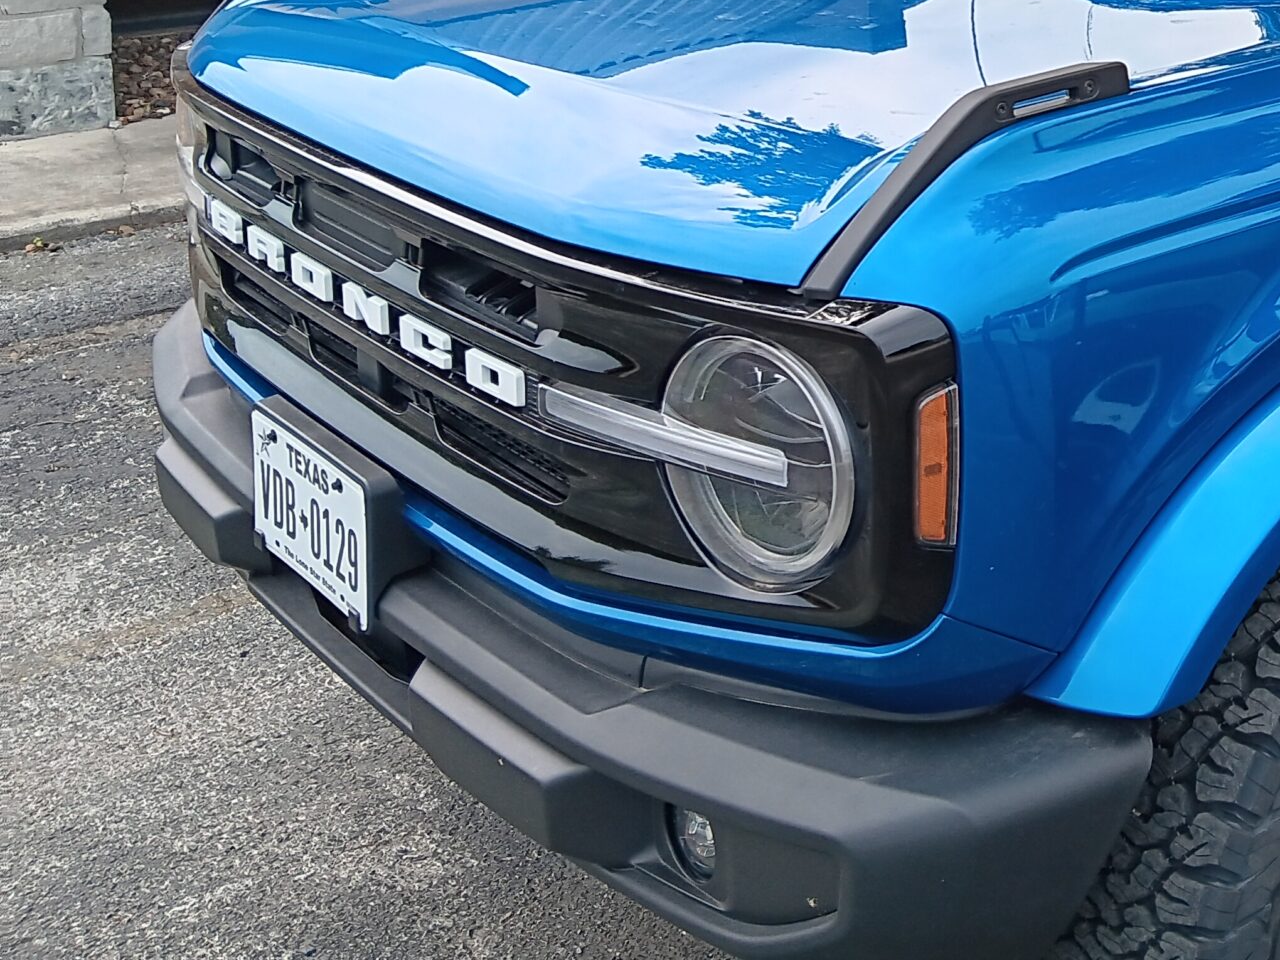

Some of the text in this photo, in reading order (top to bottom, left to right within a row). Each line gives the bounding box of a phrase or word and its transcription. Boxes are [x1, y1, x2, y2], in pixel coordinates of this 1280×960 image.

[211, 198, 526, 408] BRONCO
[260, 458, 358, 592] VDB 0129
[286, 443, 330, 495] TEXAS
